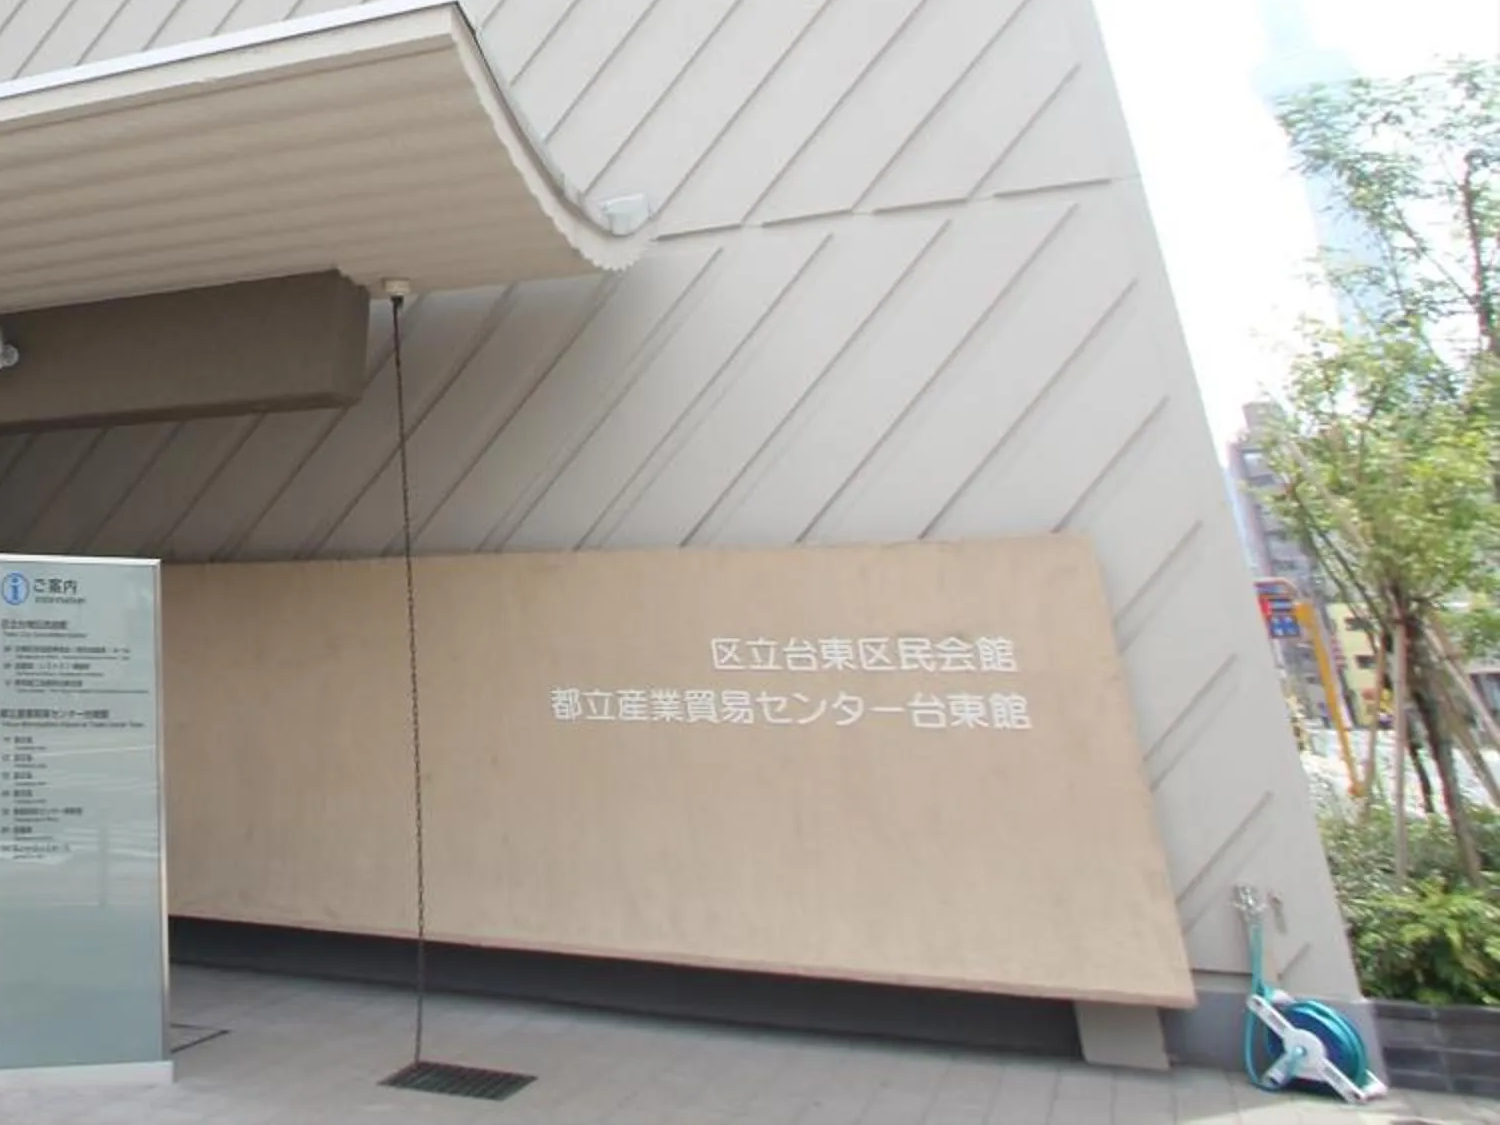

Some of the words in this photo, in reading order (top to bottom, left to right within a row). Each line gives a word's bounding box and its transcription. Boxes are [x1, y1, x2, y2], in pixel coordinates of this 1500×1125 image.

[33, 578, 78, 594] ご案内
[710, 636, 1019, 673] 区立台東区民会館
[550, 687, 1033, 731] 都立産業貿易センター台東館
